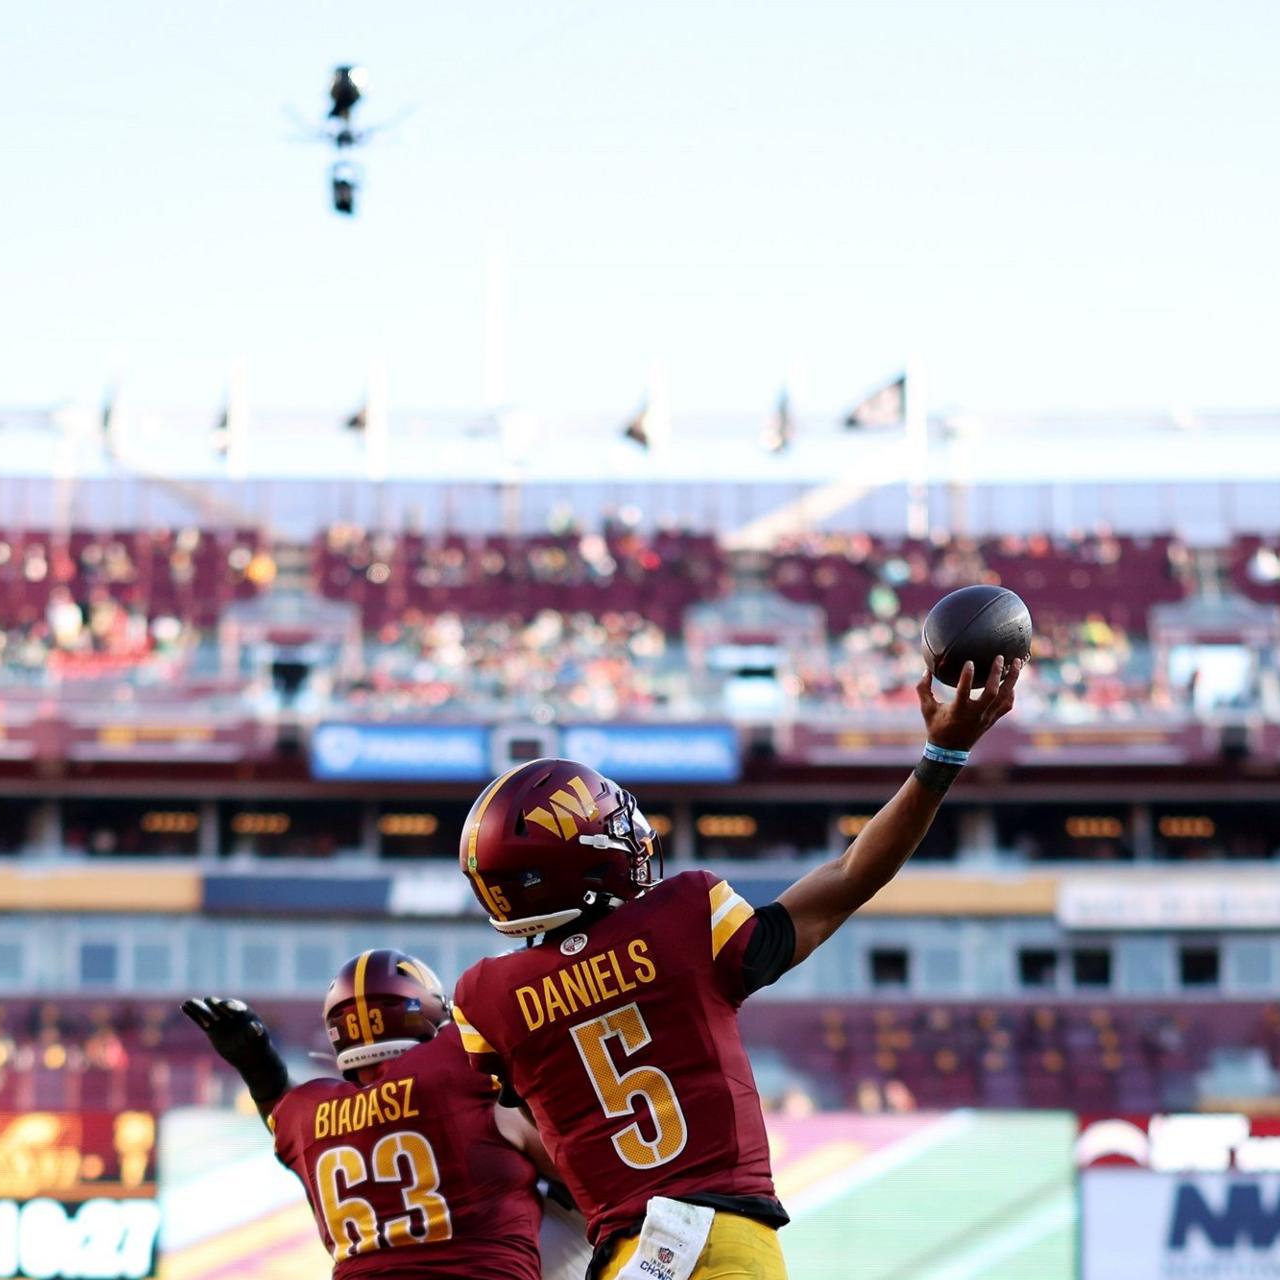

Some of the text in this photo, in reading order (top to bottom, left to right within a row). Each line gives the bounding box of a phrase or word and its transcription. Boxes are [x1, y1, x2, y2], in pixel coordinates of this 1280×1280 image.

[515, 939, 656, 1032] DANIELS
[315, 1078, 420, 1139] BIADASZ
[569, 1001, 688, 1170] 5
[315, 1131, 453, 1263] 63
